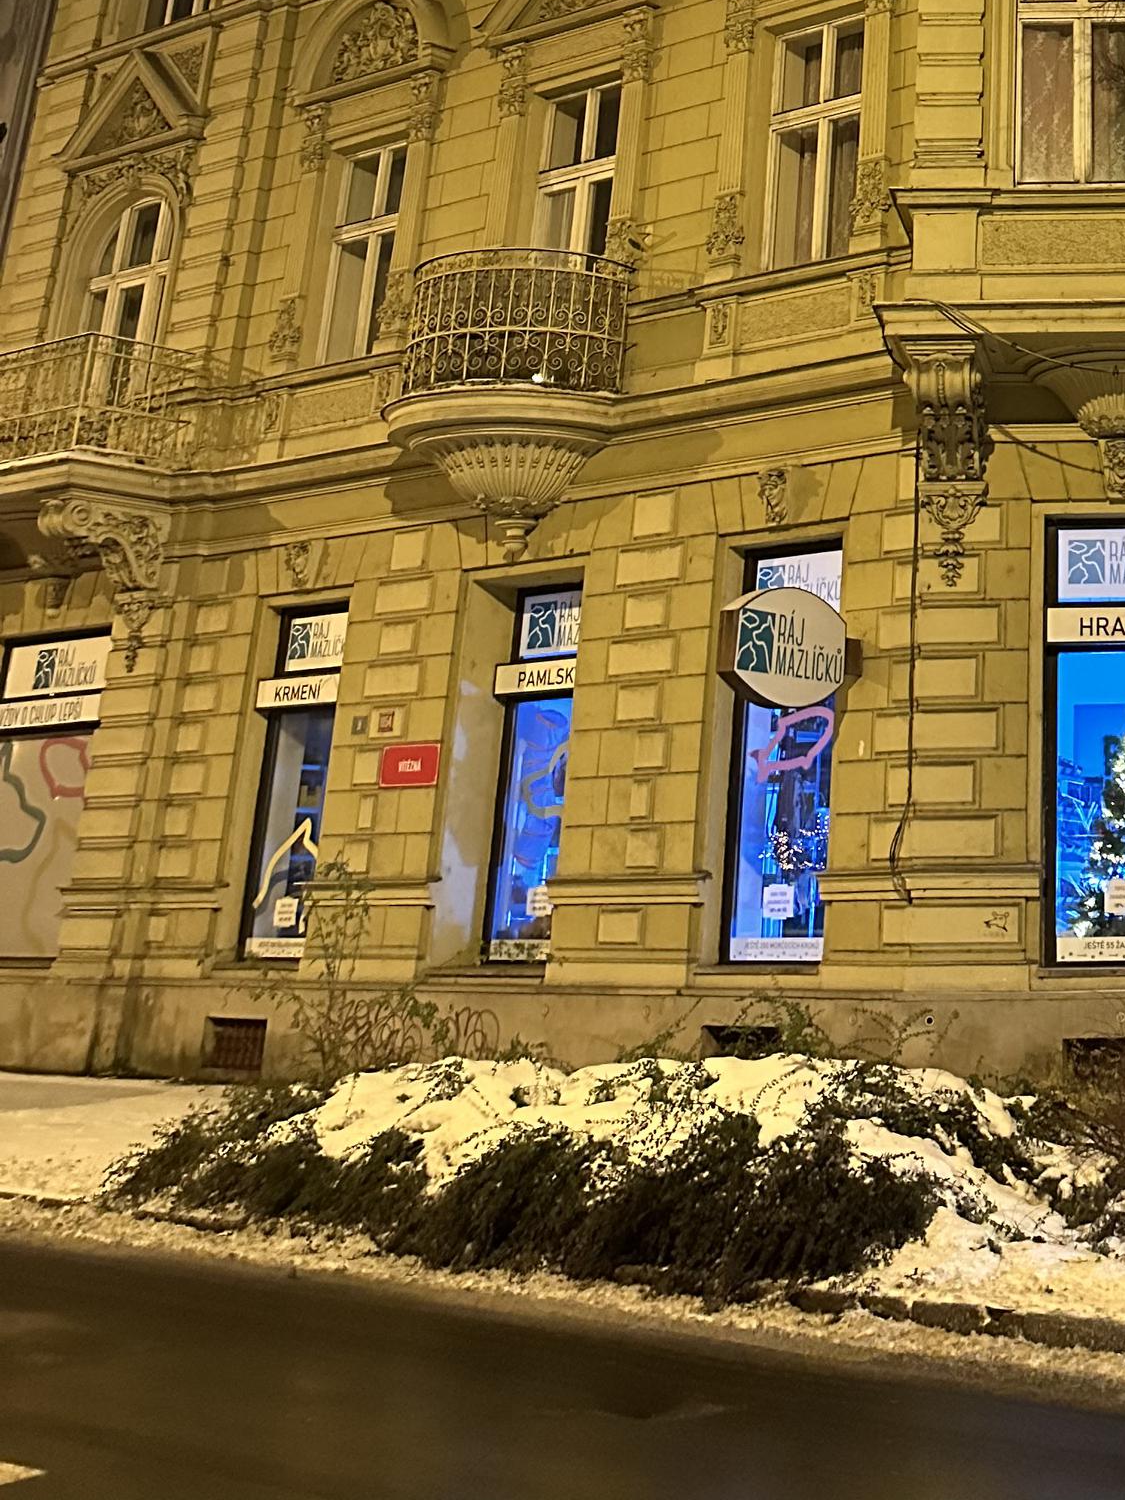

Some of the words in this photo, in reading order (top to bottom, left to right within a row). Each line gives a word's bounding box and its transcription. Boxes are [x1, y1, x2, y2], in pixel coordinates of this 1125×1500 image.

[787, 560, 810, 585] RÁJ
[778, 609, 806, 647] RÁJ
[774, 644, 843, 684] MAZLÍČKŮ
[517, 666, 575, 689] PAMLSK
[274, 678, 323, 702] KRMENÍ
[1083, 939, 1105, 950] JEŠTĚ
